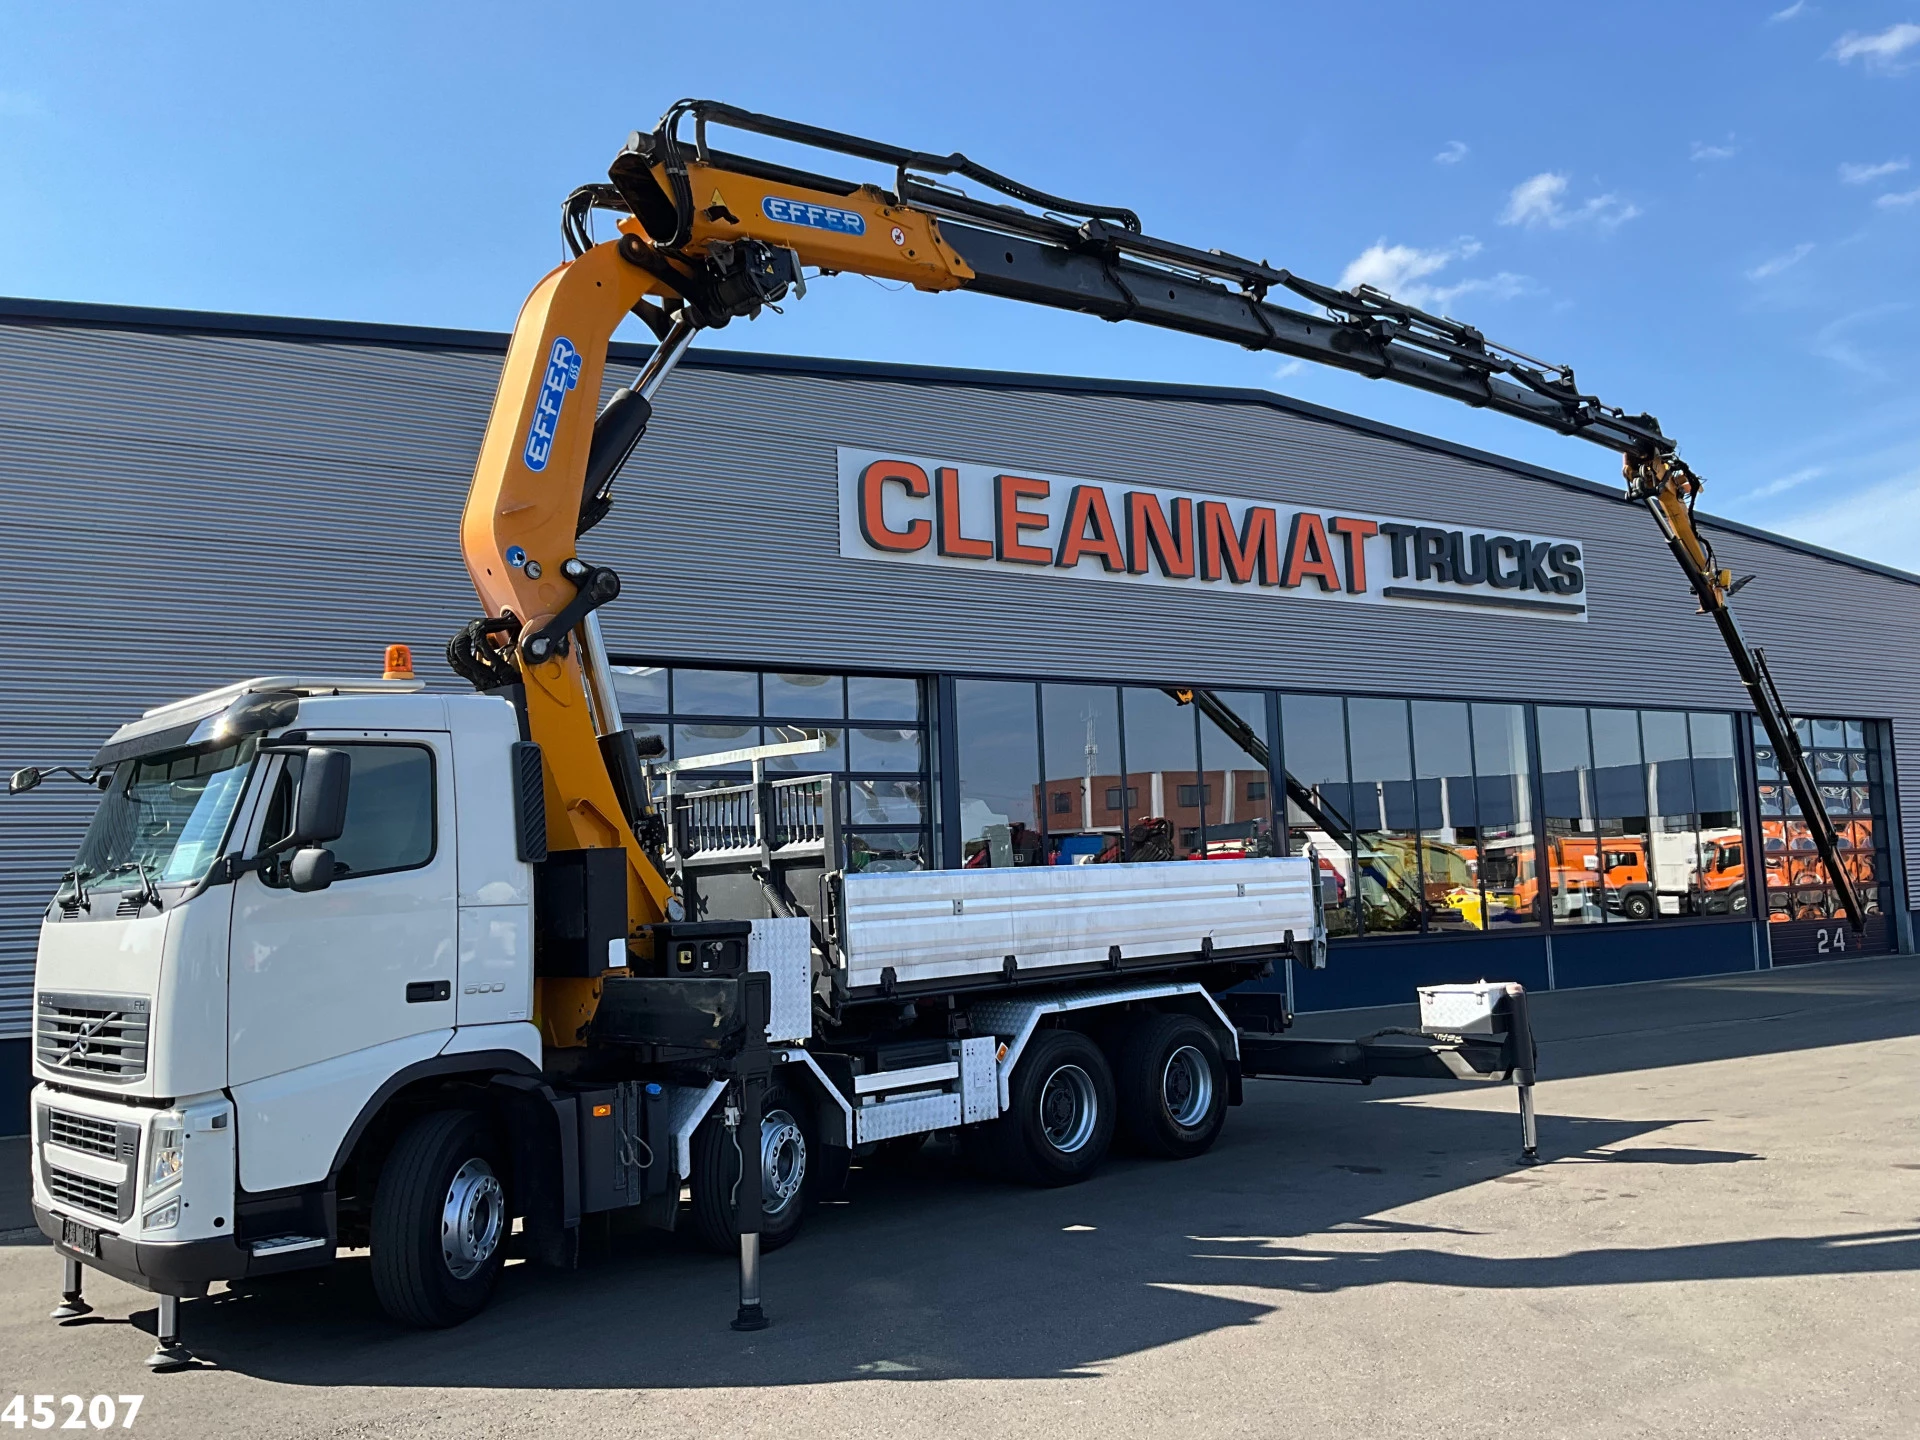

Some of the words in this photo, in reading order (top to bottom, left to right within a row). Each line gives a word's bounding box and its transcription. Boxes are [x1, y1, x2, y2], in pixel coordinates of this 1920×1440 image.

[769, 199, 861, 233] EFFER
[569, 364, 581, 380] 655
[527, 343, 573, 463] EFFER
[857, 459, 1379, 595] CLEANMAT
[1379, 522, 1585, 596] TRUCKS
[1816, 927, 1846, 954] 24
[464, 982, 506, 995] 500
[133, 1000, 146, 1011] FH
